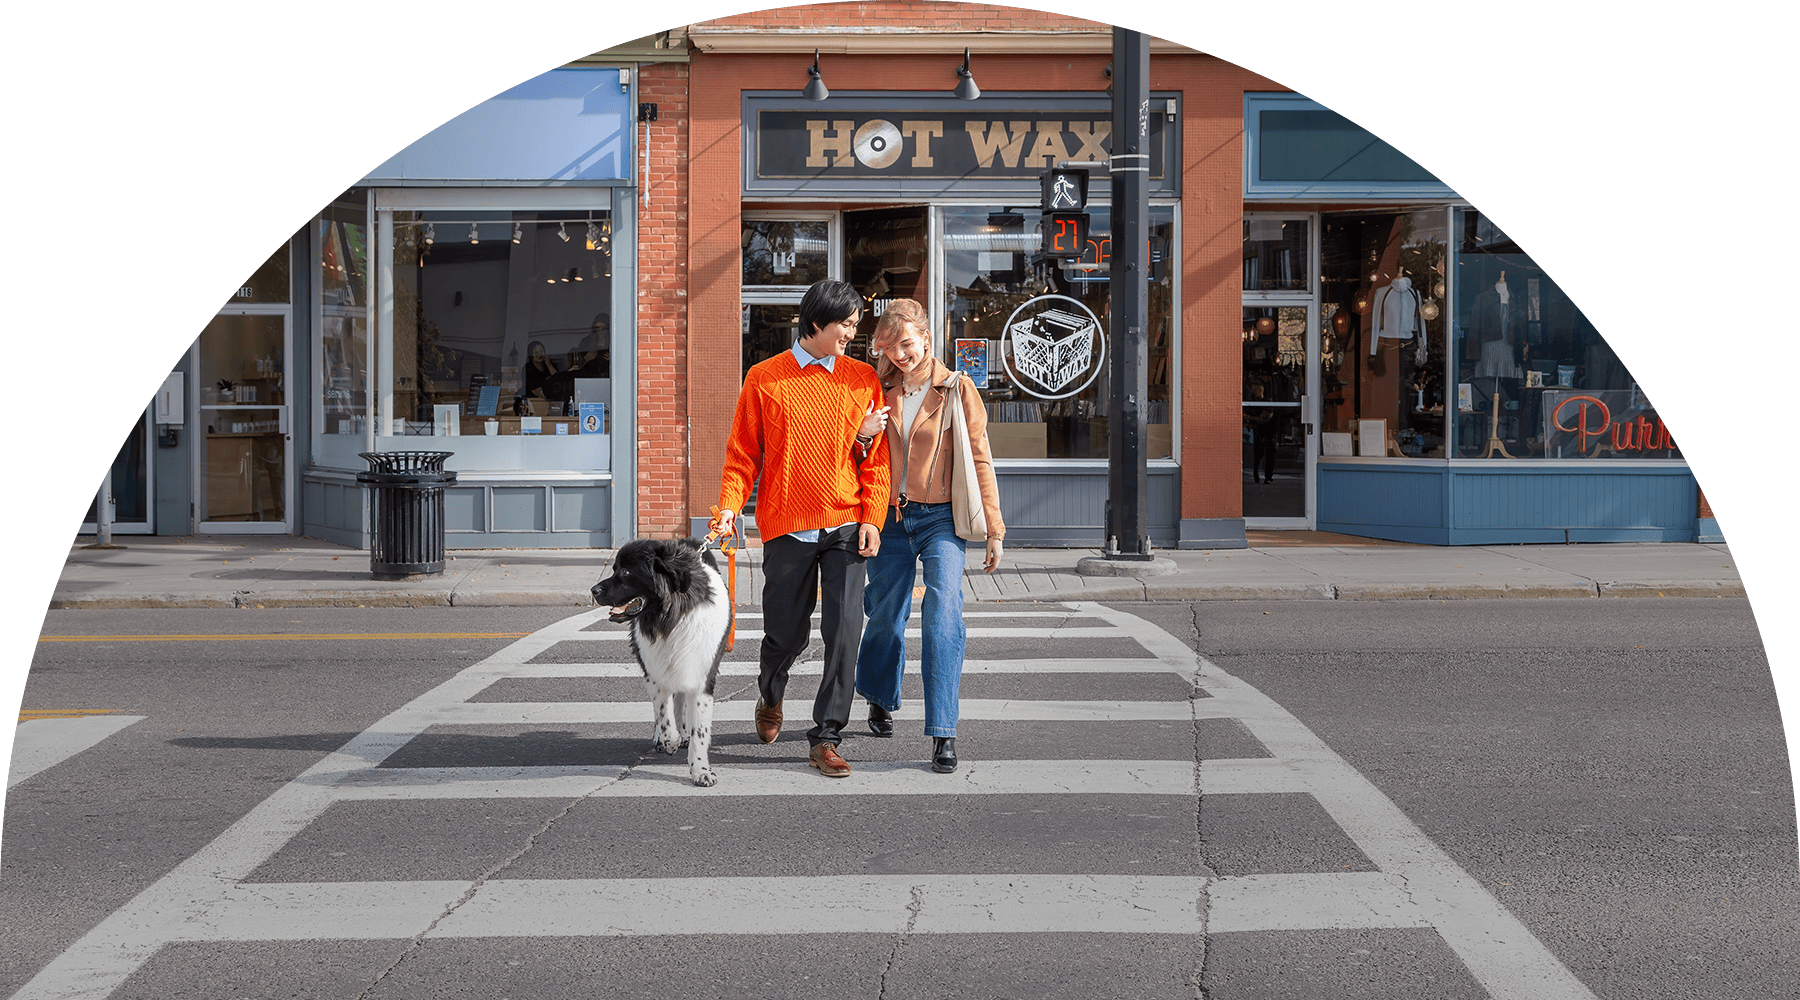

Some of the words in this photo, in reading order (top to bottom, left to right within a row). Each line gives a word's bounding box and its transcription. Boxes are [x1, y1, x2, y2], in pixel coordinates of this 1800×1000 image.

[806, 119, 943, 169] HOT
[965, 121, 1113, 168] WAX
[1054, 220, 1078, 250] 27
[773, 252, 796, 267] 114
